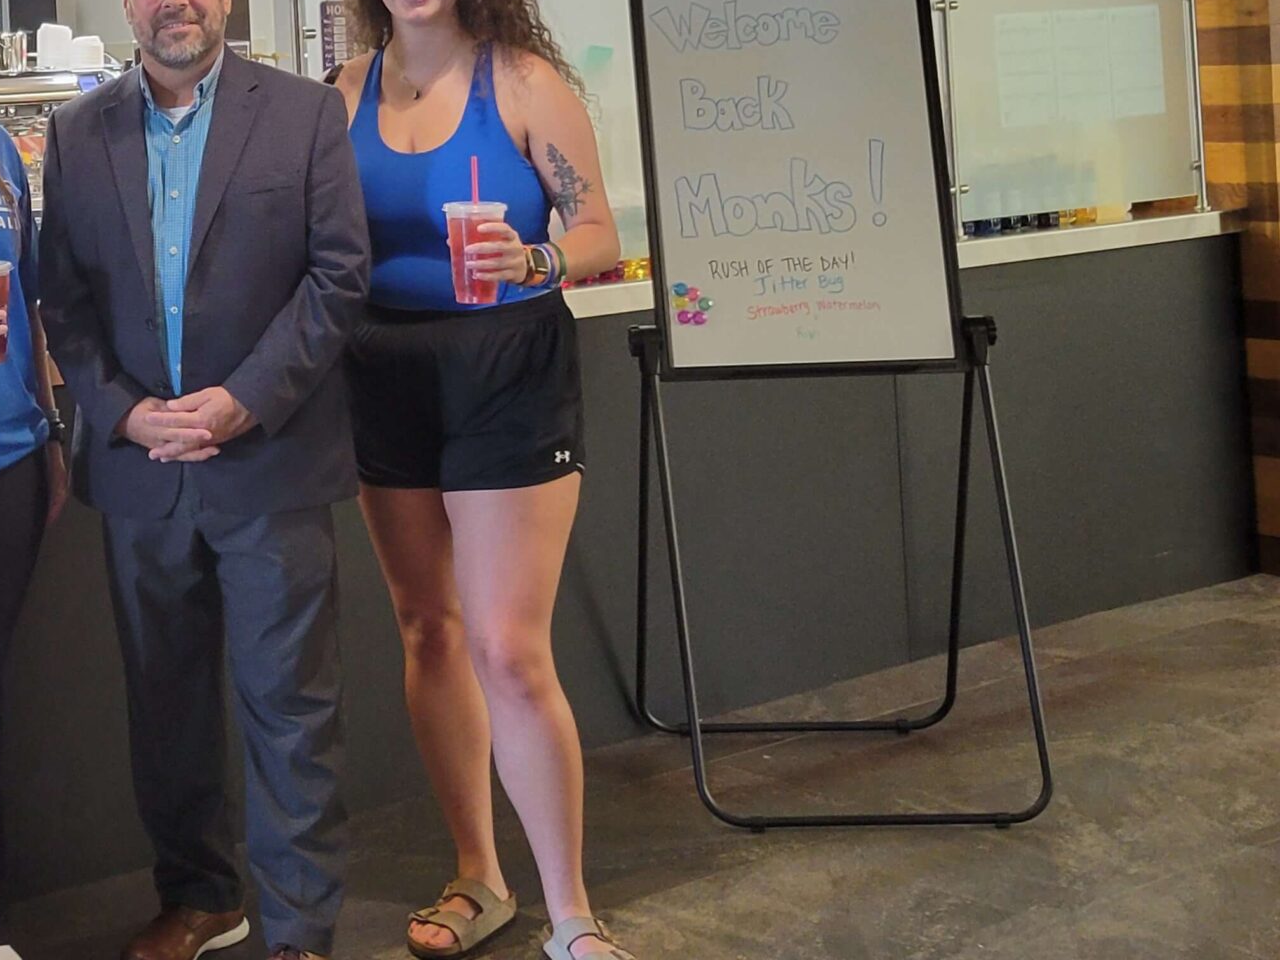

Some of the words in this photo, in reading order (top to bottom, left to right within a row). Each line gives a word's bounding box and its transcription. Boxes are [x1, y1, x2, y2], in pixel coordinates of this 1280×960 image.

[650, 0, 840, 53] Welcome
[679, 76, 795, 132] Back
[674, 138, 887, 239] Monks!
[708, 259, 749, 280] RUSH
[757, 258, 774, 274] OF
[781, 256, 813, 273] THE
[820, 251, 855, 272] DAY!
[753, 275, 807, 296] Jitter
[818, 275, 844, 293] Bug
[747, 301, 810, 320] Strawberry
